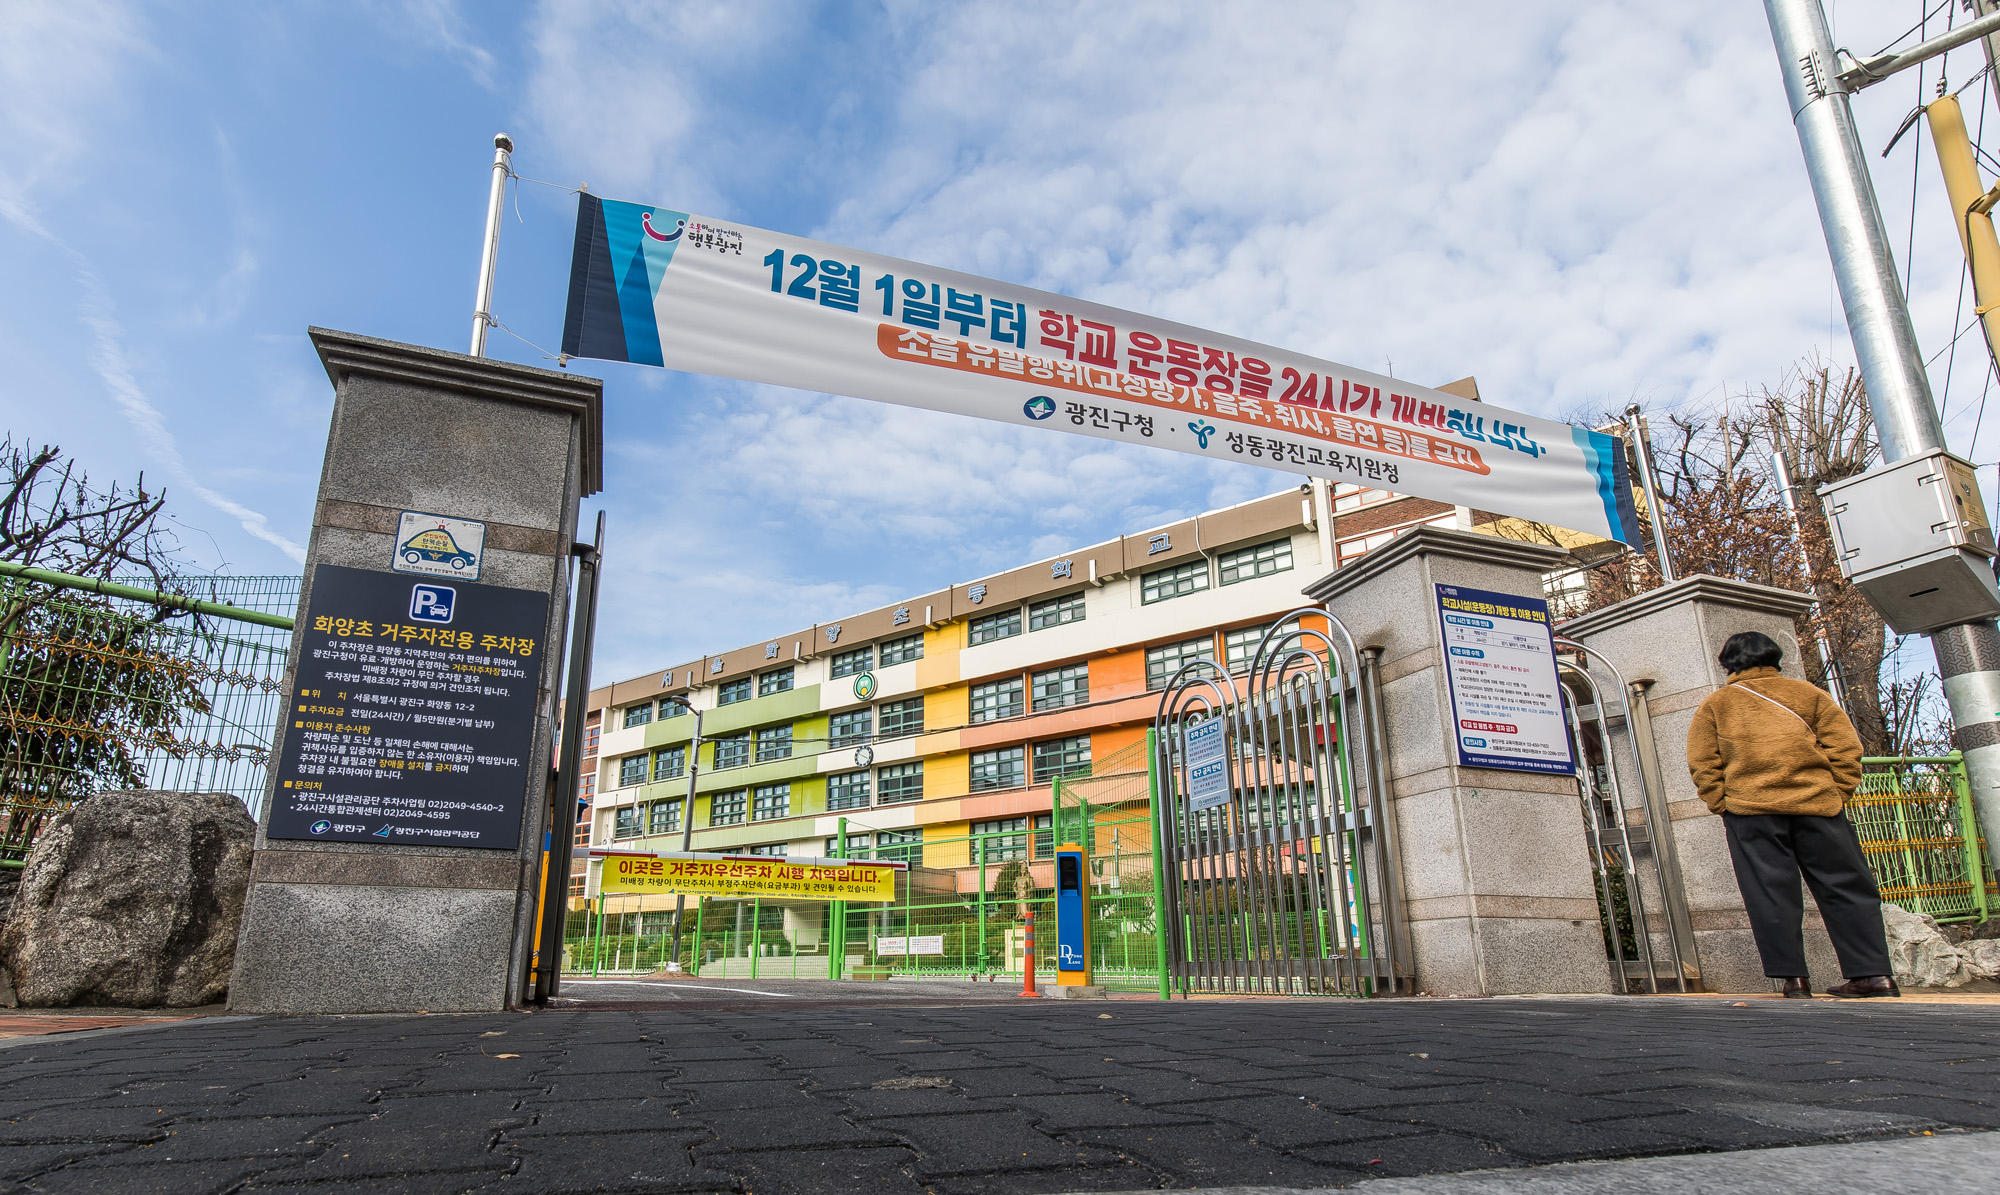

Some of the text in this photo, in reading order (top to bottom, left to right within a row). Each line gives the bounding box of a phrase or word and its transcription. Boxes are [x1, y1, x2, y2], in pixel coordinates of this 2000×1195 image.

[689, 222, 743, 241] 소통하며 발전하는
[688, 232, 742, 255] 행복광진
[764, 249, 860, 313] 12월
[875, 273, 1026, 349] 1일부터
[1039, 310, 1118, 369] 학교
[1128, 331, 1273, 399] 운동장을
[1279, 367, 1381, 418] 24시간
[897, 329, 960, 363] 소음
[1212, 391, 1271, 423] 음주,
[1273, 404, 1331, 436] 취사,
[1331, 416, 1379, 448] 흡연
[1381, 427, 1433, 460] 등)를
[1434, 440, 1481, 469] 금지
[1065, 401, 1399, 484] 광진구청 성동광진교육지원청
[414, 590, 436, 614] P
[1441, 597, 1546, 622] 학교시설(운동장) 개방 및 이용 안내
[313, 615, 535, 656] 화양초 거주자전용 주차장
[313, 648, 357, 661] 광진구청이
[416, 659, 450, 671] 운영하는
[452, 663, 527, 679] 거주자주차장입니다.
[328, 640, 517, 668] 이 주차장은 화양동 지역주민의 주차 편의를 위하여
[324, 671, 511, 697] 주차장법 제8조의2 규정에 의거 견인조치 됩니다.
[361, 664, 480, 684] 미배정 차량이 무단 주차할 경우
[311, 689, 475, 712] 위 치 서울특별시 광진구 화양동 12-2
[306, 721, 371, 735] 이용자 준수사항
[308, 705, 495, 730] 주차요금 전일(24시간) / 월5만원(분기별 납부)
[303, 731, 474, 753] 차량파손 및 도난 등 일체의 손해에 대해서는
[299, 753, 469, 774] 주차장 내 불필요한 장애물 설치를 금지하며
[302, 742, 520, 767] 귀책사유를 입증하지 않는 한 소유자(이용자) 책임입니다.
[297, 763, 404, 780] 청결을 유지하여야 합니다.
[294, 780, 323, 791] 문의처
[296, 803, 451, 820] 24시간통합관제센터 02)2049-4595
[298, 791, 504, 812] 광진구시설관리공단 주차사업팀 02)2049-4540~2
[332, 823, 366, 833] 광진구
[395, 827, 480, 839] 광진구시설관리공단
[619, 860, 882, 884] 이곳은 거주자우선주차 시행 지역입니다.
[620, 876, 645, 886] 미배정
[647, 877, 672, 887] 차량이
[674, 878, 715, 888] 무단주차시
[716, 878, 801, 892] 부정주차단속(요금부과)
[803, 882, 811, 892] 및
[813, 882, 835, 892] 견인될
[837, 884, 845, 892] 수
[847, 884, 878, 894] 있습니다.
